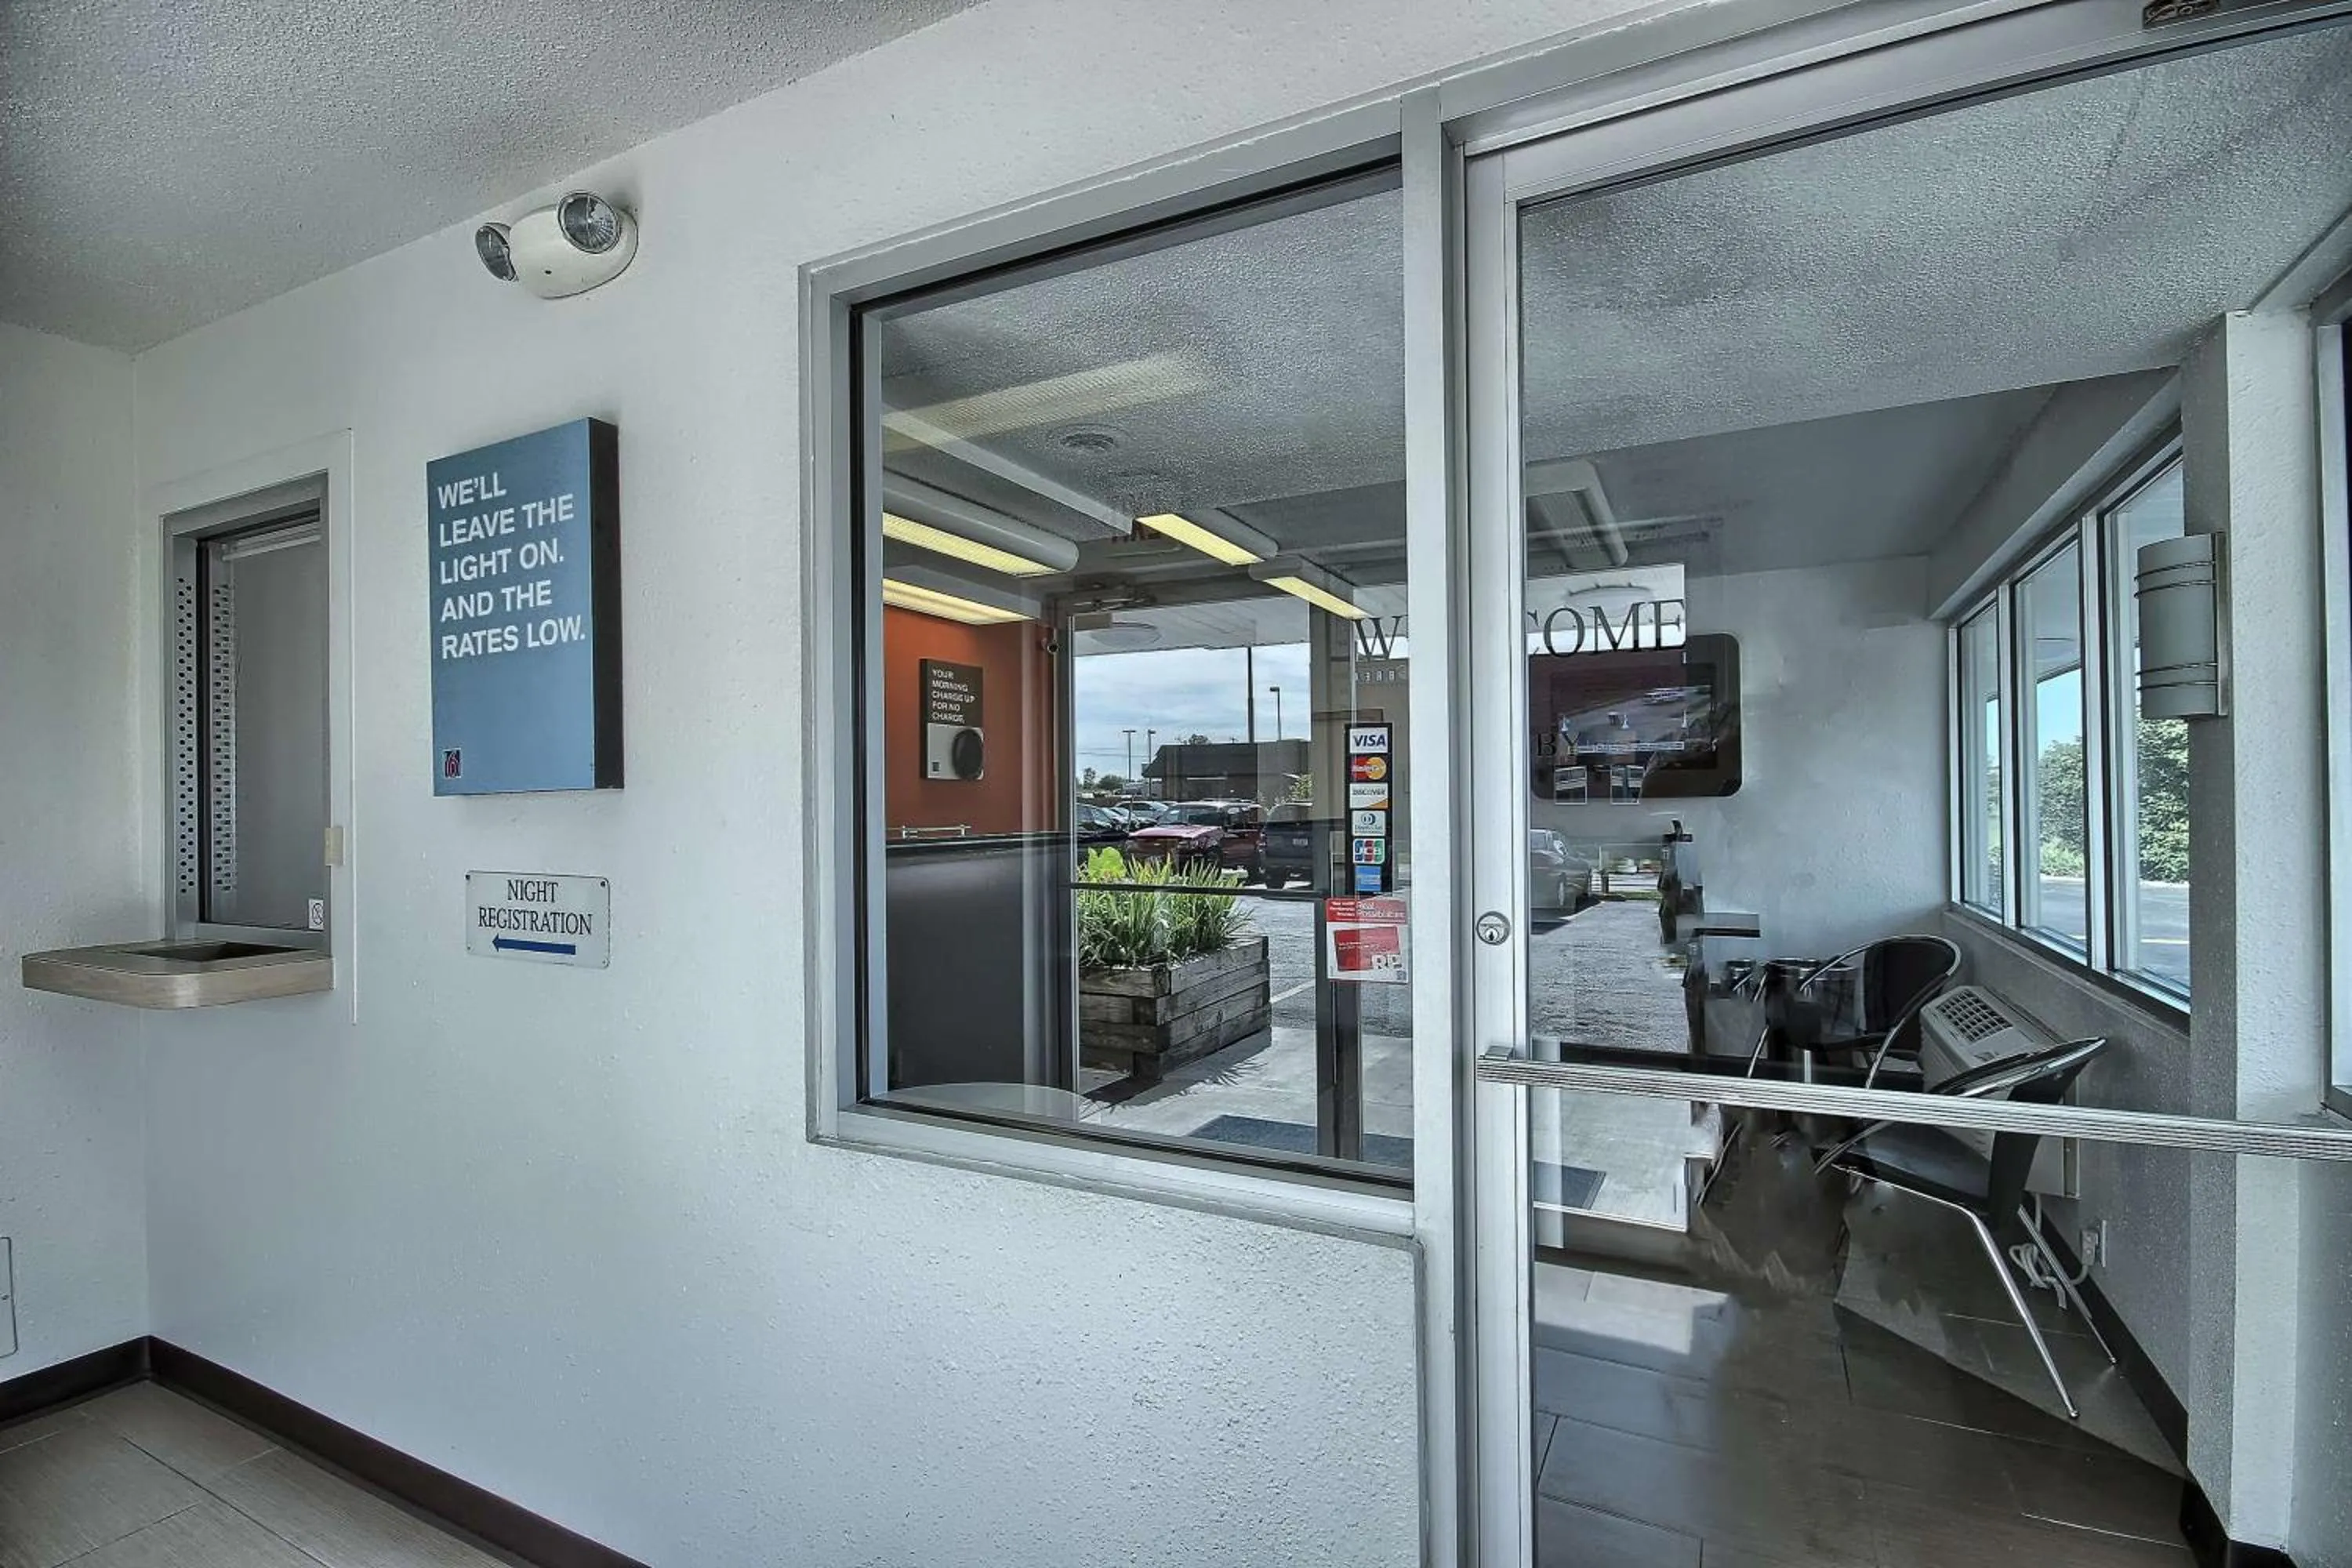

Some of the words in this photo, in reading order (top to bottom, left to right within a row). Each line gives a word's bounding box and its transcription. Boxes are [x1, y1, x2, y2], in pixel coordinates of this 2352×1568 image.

[437, 472, 506, 509] WE'LL
[440, 508, 515, 547] LEAVE
[522, 494, 575, 530] THE
[441, 548, 513, 585] LIGHT
[520, 538, 565, 571] ON.
[441, 590, 494, 622] AND
[501, 580, 552, 612] THE
[441, 625, 519, 659] RATES
[527, 615, 586, 648] LOW.
[932, 669, 954, 679] YOUR
[932, 680, 968, 691] MORNING
[931, 691, 964, 702] CHARGE
[964, 693, 976, 703] UP
[932, 701, 948, 710] FOR
[949, 703, 960, 712] NO
[1352, 735, 1387, 747] VISA
[507, 879, 559, 903] NIGHT
[478, 906, 593, 935] REGISTRATION
